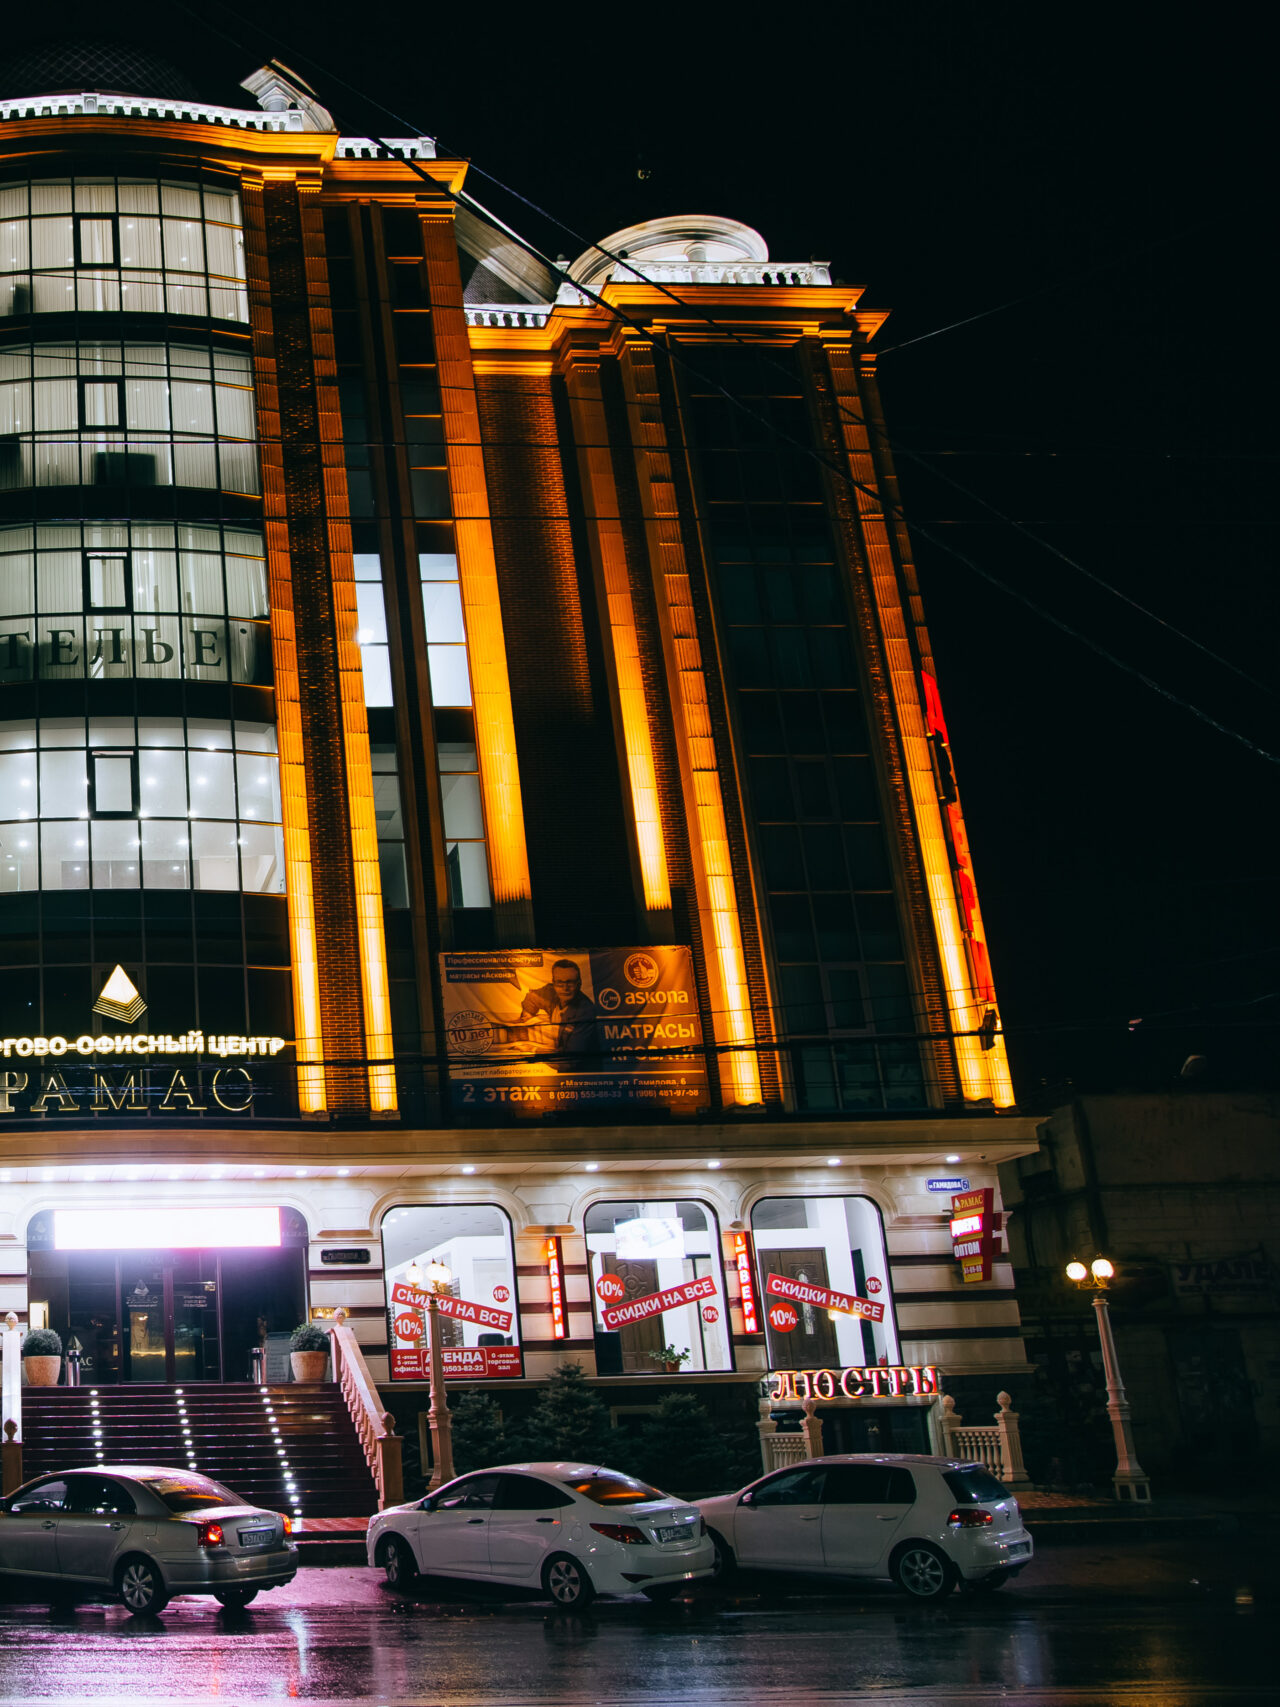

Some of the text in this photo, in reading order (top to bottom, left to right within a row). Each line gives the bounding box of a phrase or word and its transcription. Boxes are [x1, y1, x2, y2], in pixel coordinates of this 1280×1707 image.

[625, 991, 689, 1005] askona
[451, 1029, 490, 1042] 10 лет
[604, 1023, 696, 1040] МАТРАСЫ
[207, 1035, 286, 1057] ЦЕНТР
[463, 1085, 542, 1102] 2 этаж
[549, 1092, 555, 1100] 8
[556, 1091, 579, 1101] (928)
[961, 1195, 983, 1208] РАМАС
[953, 1241, 980, 1258] ОПТОМ
[597, 1280, 623, 1297] 10%
[737, 1252, 756, 1332] ДВЕРИ
[866, 1281, 882, 1290] 10%
[493, 1289, 509, 1300] 10%
[549, 1258, 564, 1338] ДВЕРИ
[607, 1280, 713, 1324] СКИДКИ НА ВСЕ
[771, 1279, 882, 1319] СКИДКИ НА ВСЕ
[455, 1304, 476, 1319] НА
[479, 1309, 509, 1327] ВСЕ
[702, 1309, 718, 1320] 10%
[770, 1308, 796, 1325] 10%
[395, 1318, 422, 1335] 10%
[425, 1351, 483, 1365] АЕНДА
[487, 1358, 520, 1366] торговый
[394, 1365, 422, 1374] офисы
[771, 1365, 940, 1401] ЛЮСТРЫ
